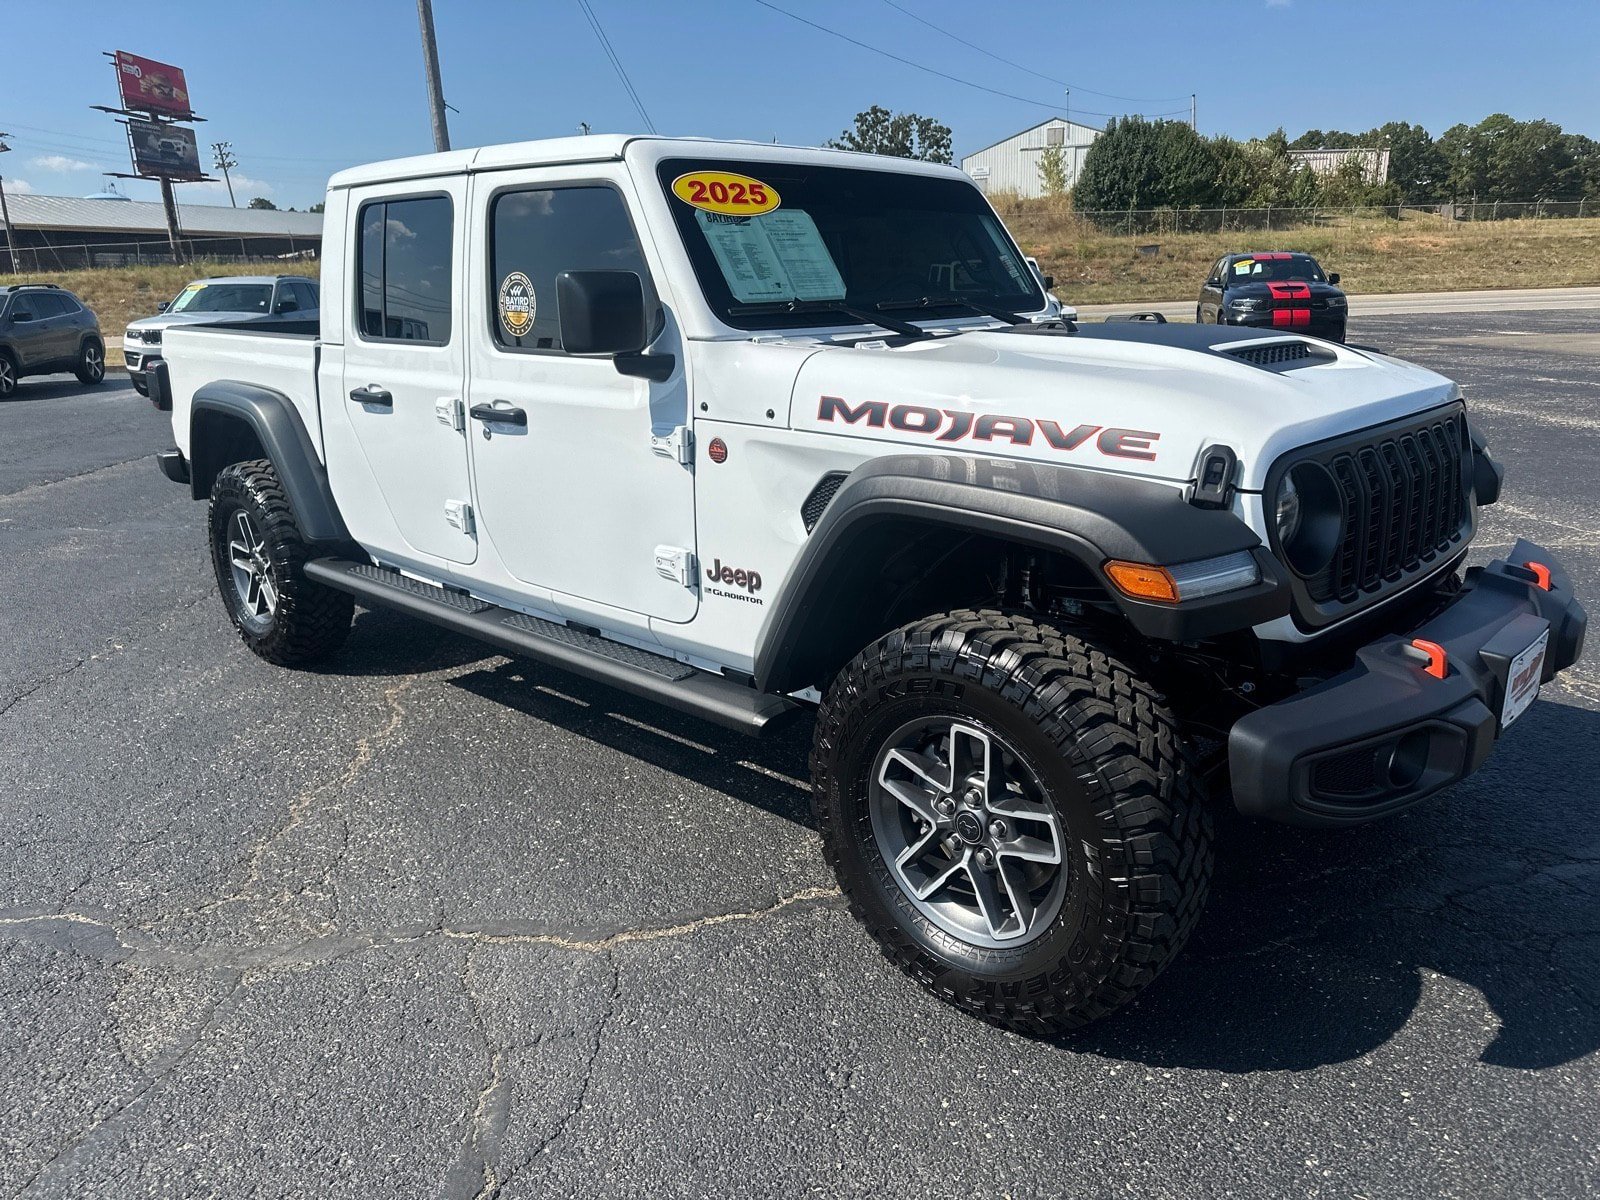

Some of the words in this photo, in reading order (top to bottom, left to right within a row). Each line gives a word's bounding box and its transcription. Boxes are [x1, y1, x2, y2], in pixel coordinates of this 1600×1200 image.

[688, 180, 767, 205] 2025
[505, 296, 529, 305] BAYIRD
[817, 395, 1161, 462] MOJAVE
[706, 558, 762, 594] Jeep
[712, 588, 764, 605] GLADIATOR
